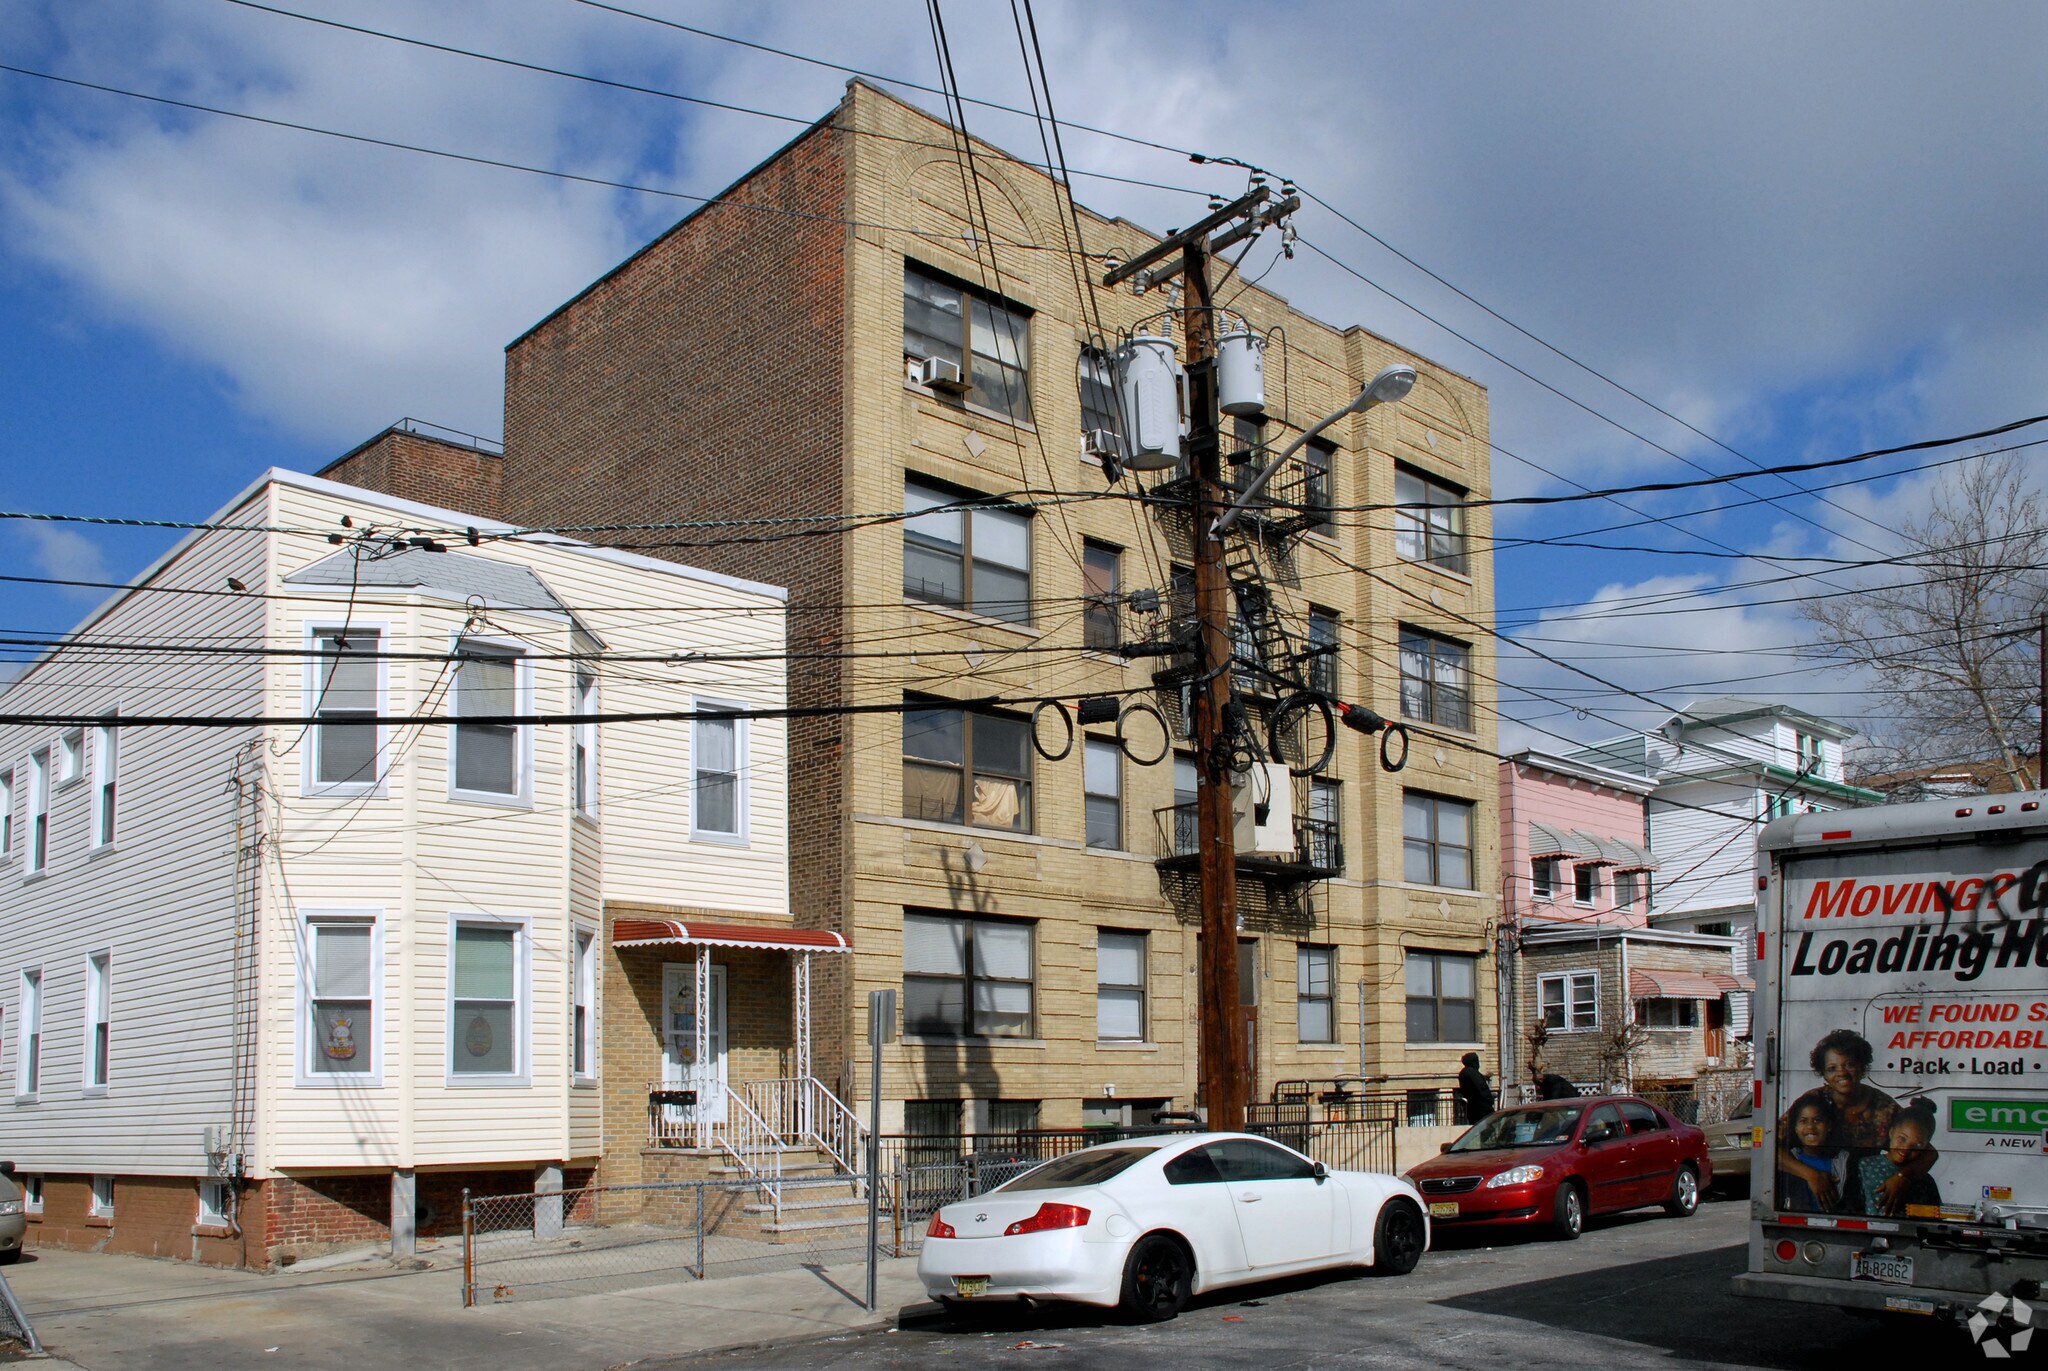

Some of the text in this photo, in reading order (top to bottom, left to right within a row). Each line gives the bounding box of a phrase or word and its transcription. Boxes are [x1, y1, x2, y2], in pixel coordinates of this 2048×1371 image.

[1790, 918, 2048, 982] Loading H
[1883, 1002, 2048, 1024] WE FOUND S
[1900, 1057, 2024, 1076] Pack Load
[1985, 1137, 1996, 1147] A
[2000, 1138, 2036, 1148] NEW
